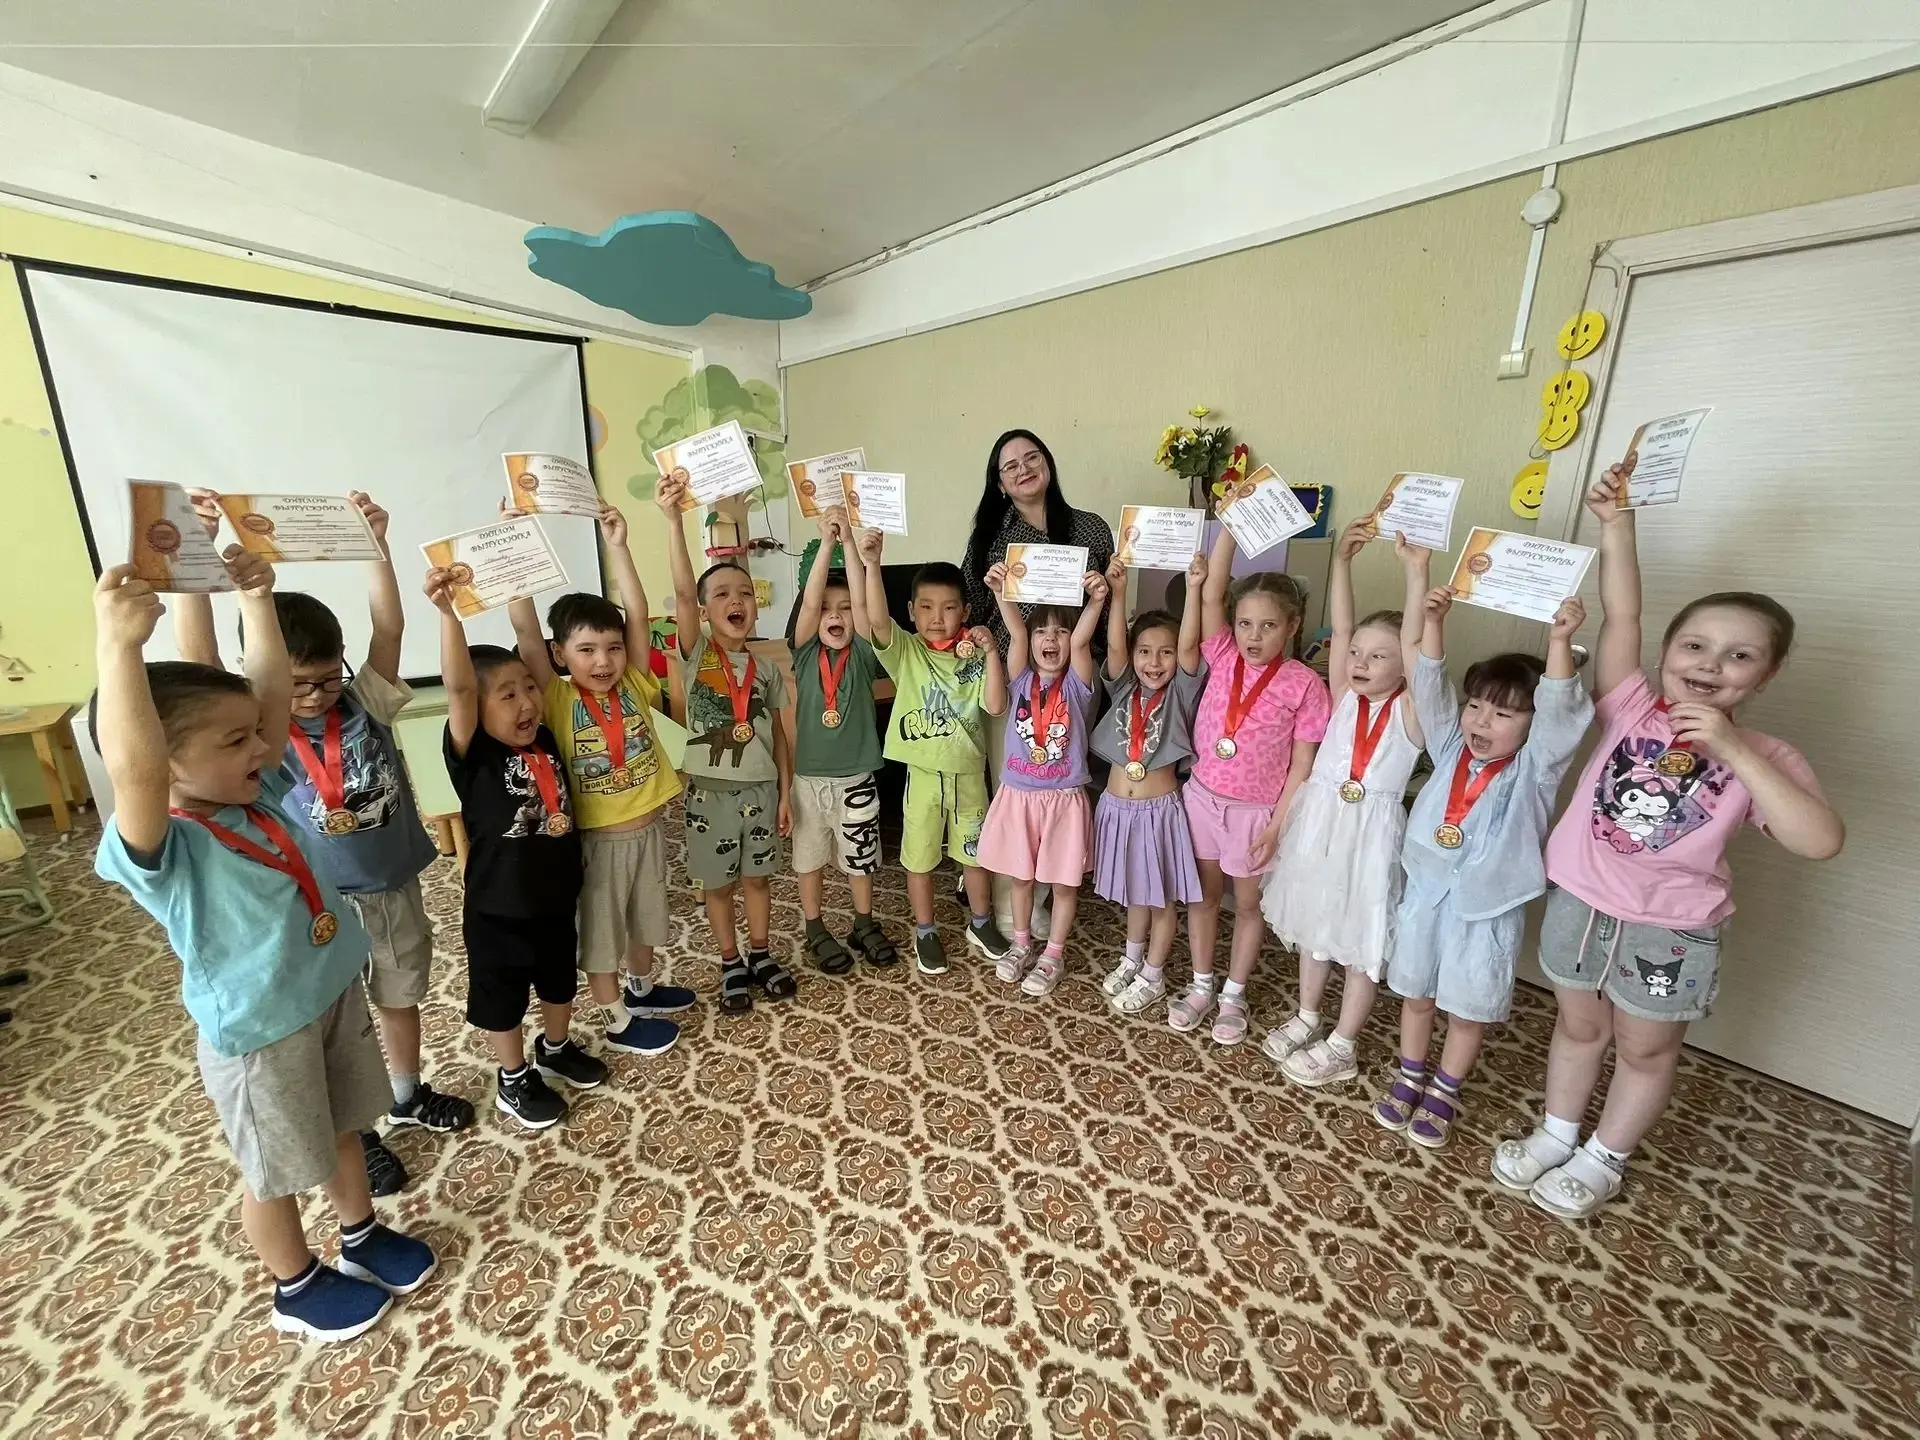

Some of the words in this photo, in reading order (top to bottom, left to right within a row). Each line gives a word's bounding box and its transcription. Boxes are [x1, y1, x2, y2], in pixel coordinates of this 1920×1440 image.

[479, 525, 516, 540] ДИПЛОМ
[470, 530, 531, 553] ВЫПУСКНИКА
[1522, 541, 1567, 555] ДИПЛОМ
[1504, 547, 1577, 567] ВЫПУСКНИЦЫ
[899, 707, 957, 741] RULES
[584, 779, 611, 790] WORLD
